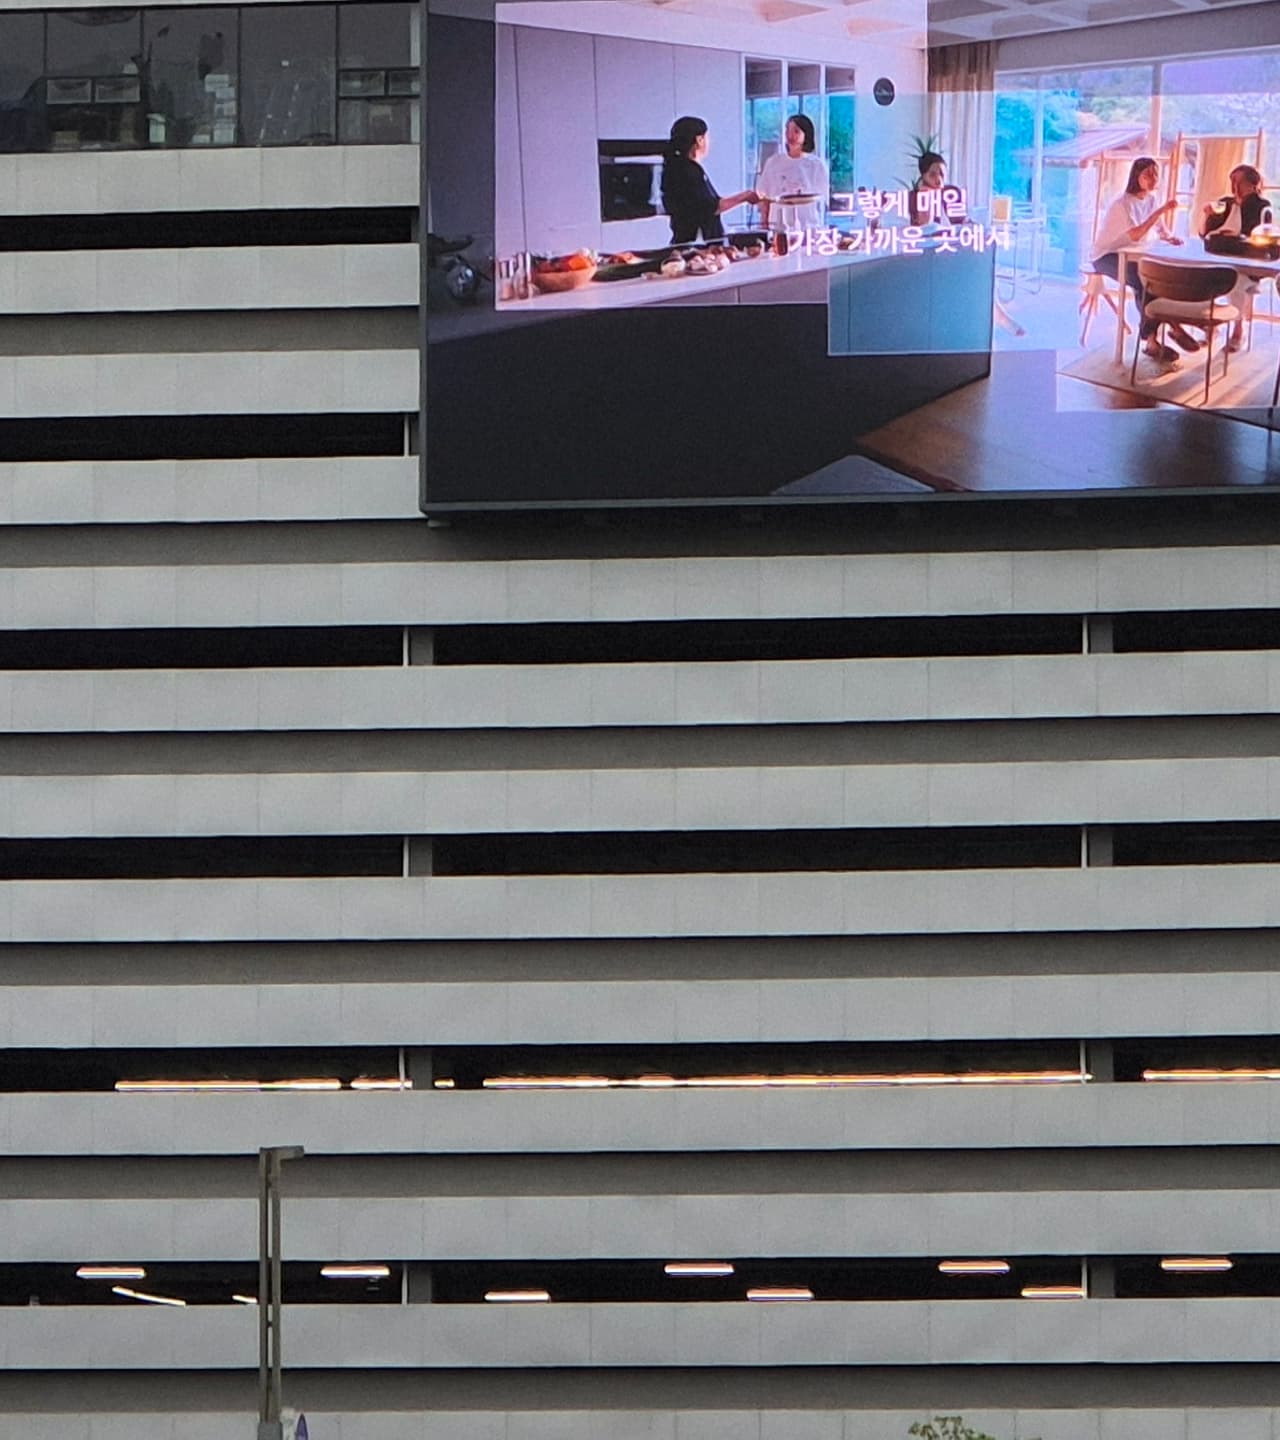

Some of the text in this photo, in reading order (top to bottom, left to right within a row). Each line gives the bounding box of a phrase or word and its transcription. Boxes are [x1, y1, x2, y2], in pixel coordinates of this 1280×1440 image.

[831, 187, 968, 218] 그렇게 매일
[787, 222, 1010, 256] 가장 가까운 곳에서
